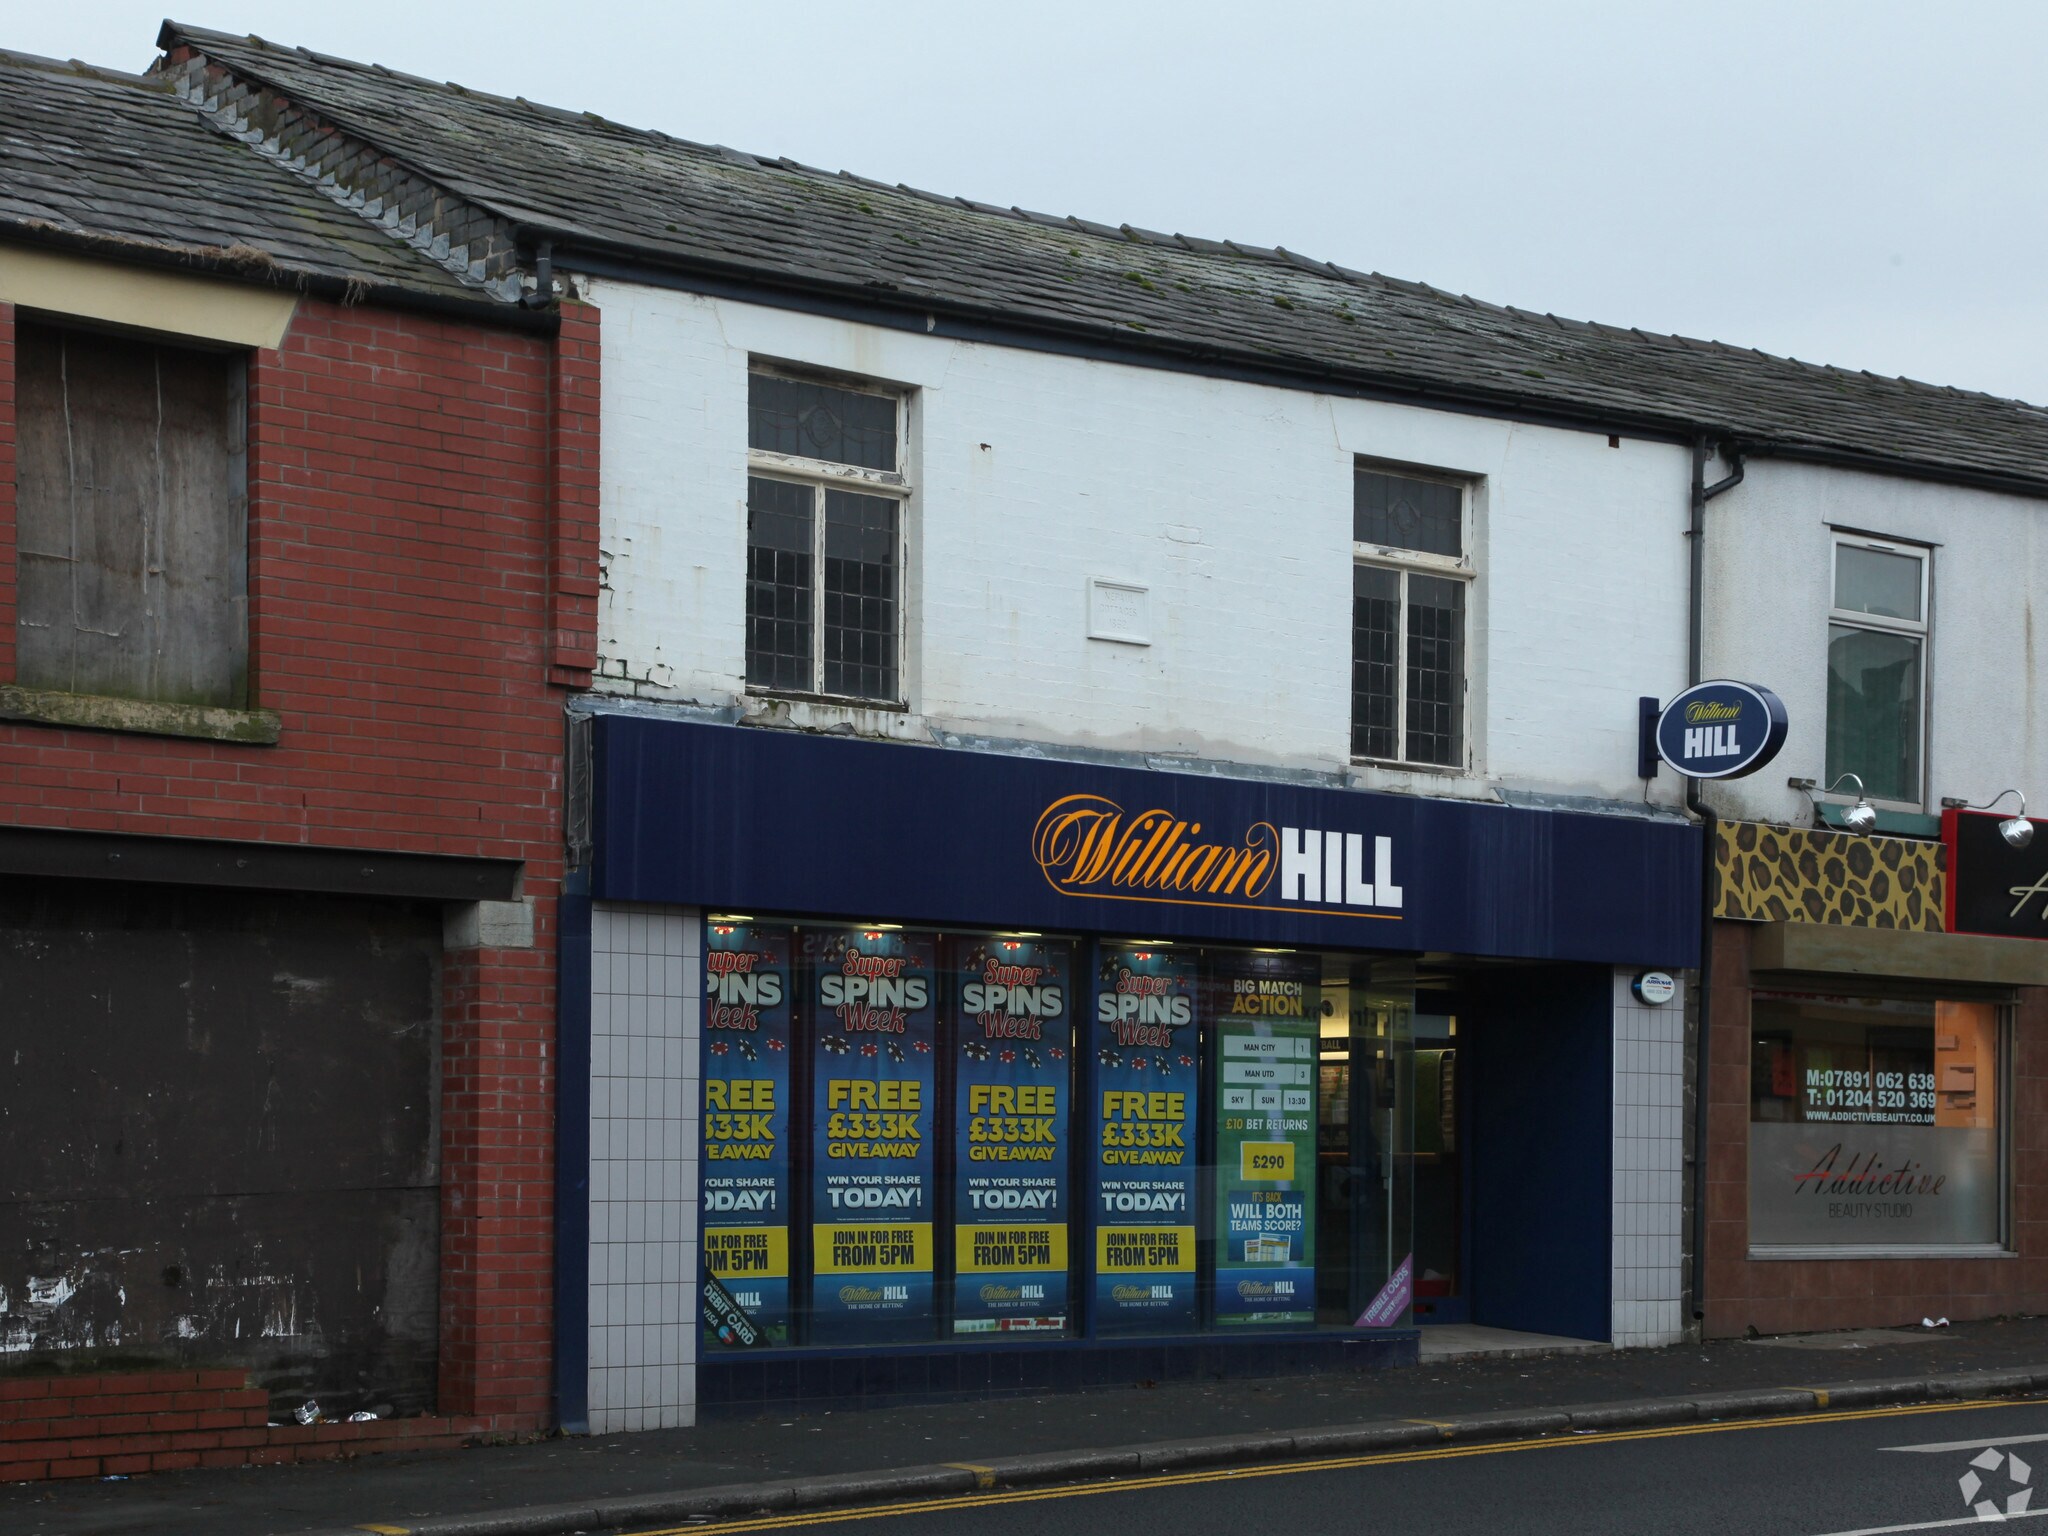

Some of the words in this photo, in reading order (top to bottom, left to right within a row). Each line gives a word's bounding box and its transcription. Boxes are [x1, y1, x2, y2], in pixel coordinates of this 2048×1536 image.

[1685, 700, 1742, 724] William
[1684, 725, 1740, 759] HILL
[1033, 794, 1280, 899] William
[1281, 826, 1402, 908] HILL
[707, 950, 758, 981] uper
[843, 949, 906, 982] Super
[983, 959, 1042, 991] Super
[821, 976, 928, 1009] SPINS
[1116, 969, 1171, 999] Super
[1234, 980, 1255, 992] BIG
[1259, 980, 1302, 995] MATCH
[963, 984, 1063, 1016] SPINS
[1099, 995, 1191, 1024] SPINS
[1232, 996, 1302, 1016] ACTION
[836, 1001, 907, 1033] Week
[978, 1009, 1042, 1040] Week
[1111, 1018, 1171, 1048] Week
[1244, 1043, 1258, 1051] MAN
[1262, 1070, 1274, 1078] UTD
[1807, 1069, 1870, 1087] M:07891
[1876, 1072, 1903, 1089] 062
[1908, 1073, 1935, 1090] 638
[828, 1079, 922, 1110] FREE
[969, 1085, 1056, 1115] FREE
[1231, 1096, 1244, 1104] SKY
[1261, 1096, 1275, 1105] SUN
[1288, 1097, 1306, 1105] 13:30
[1807, 1089, 1821, 1105] T:
[1826, 1089, 1873, 1107] 01204
[1878, 1092, 1905, 1107] 520
[1910, 1092, 1936, 1108] 369
[1103, 1091, 1185, 1120] FREE
[828, 1114, 922, 1139] £333K
[1226, 1119, 1243, 1130] £10
[1246, 1119, 1263, 1130] BET
[1266, 1119, 1308, 1131] RETURNS
[1806, 1111, 1936, 1123] WWW.ADDICTIVEBEAUTY.CO.UK
[969, 1118, 1056, 1143] £333K
[1103, 1123, 1185, 1147] £333K
[705, 1145, 774, 1160] EAWAY
[828, 1143, 920, 1159] GIVEAWAY
[969, 1146, 1055, 1161] GIVEAWAY
[1102, 1150, 1184, 1165] GIVEAWAY
[1253, 1156, 1284, 1168] £290
[1794, 1143, 1946, 1195] Addictive
[736, 1177, 775, 1187] SHARE
[827, 1176, 849, 1185] WIN
[851, 1176, 883, 1184] YOUR
[884, 1175, 921, 1184] SHARE
[969, 1178, 990, 1187] WIN
[991, 1178, 1020, 1186] YOUR
[1022, 1177, 1056, 1186] SHARE
[1102, 1182, 1121, 1190] WIN
[1123, 1182, 1150, 1190] YOUR
[1152, 1181, 1184, 1190] SHARE
[827, 1187, 922, 1208] TODAY!
[969, 1189, 1057, 1209] TODAY!
[1102, 1193, 1185, 1212] TODAY!
[1266, 1192, 1282, 1202] BACK
[1231, 1204, 1263, 1219] WILL
[1267, 1204, 1302, 1218] BOTH
[1829, 1203, 1872, 1218] BEAUTY
[1874, 1203, 1913, 1218] STUDIO
[1231, 1220, 1262, 1231] TEAMS
[1264, 1220, 1302, 1231] SCORE?
[722, 1235, 741, 1249] FOR
[743, 1234, 767, 1248] FREE
[833, 1230, 856, 1245] JOIN
[857, 1230, 867, 1244] IN
[870, 1230, 889, 1244] FOR
[890, 1230, 914, 1244] FREE
[974, 1231, 994, 1245] JOIN
[997, 1231, 1006, 1244] IN
[1009, 1231, 1027, 1244] FOR
[1030, 1231, 1050, 1244] FREE
[1107, 1233, 1126, 1246] JOIN
[1129, 1233, 1137, 1245] IN
[1139, 1233, 1156, 1245] FOR
[1159, 1233, 1178, 1244] FREE
[732, 1249, 768, 1270] 5PM
[833, 1246, 877, 1266] FROM
[880, 1245, 914, 1265] 5PM
[974, 1246, 1015, 1266] FROM
[1018, 1245, 1050, 1265] 5PM
[1107, 1247, 1146, 1266] FROM
[1149, 1246, 1179, 1265] 5PM
[884, 1286, 908, 1300] HILL
[1022, 1285, 1044, 1299] HILL
[1151, 1285, 1173, 1299] HILL
[1274, 1281, 1295, 1294] HILL
[1364, 1292, 1389, 1324] TREBLE
[1387, 1266, 1409, 1294] ODDS
[736, 1292, 761, 1306] HILL
[704, 1284, 729, 1315] DEBIT
[727, 1313, 754, 1345] CARD
[704, 1308, 718, 1327] VISA
[1379, 1300, 1397, 1323] LUCKY
